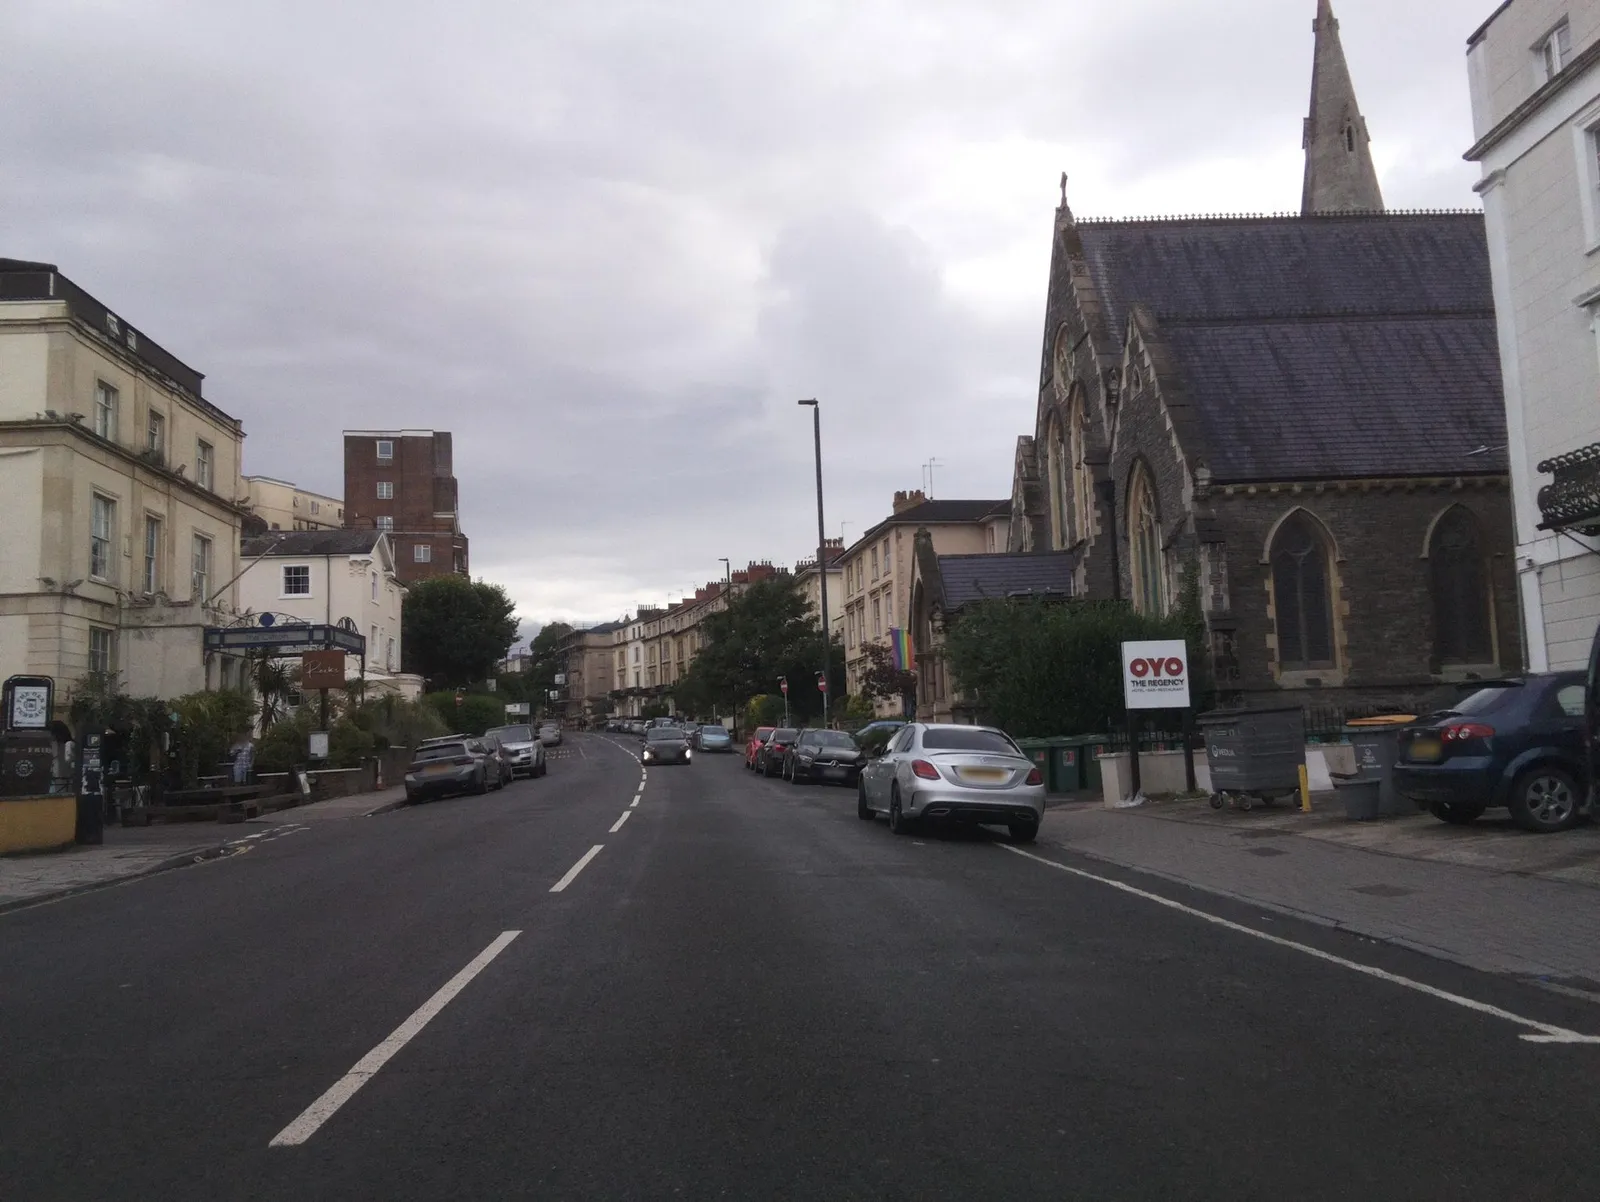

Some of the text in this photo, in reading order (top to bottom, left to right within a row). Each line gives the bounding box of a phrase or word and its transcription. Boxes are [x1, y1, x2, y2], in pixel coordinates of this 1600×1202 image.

[1130, 657, 1183, 677] OYO
[1148, 679, 1184, 687] REGENCY
[91, 736, 98, 744] P
